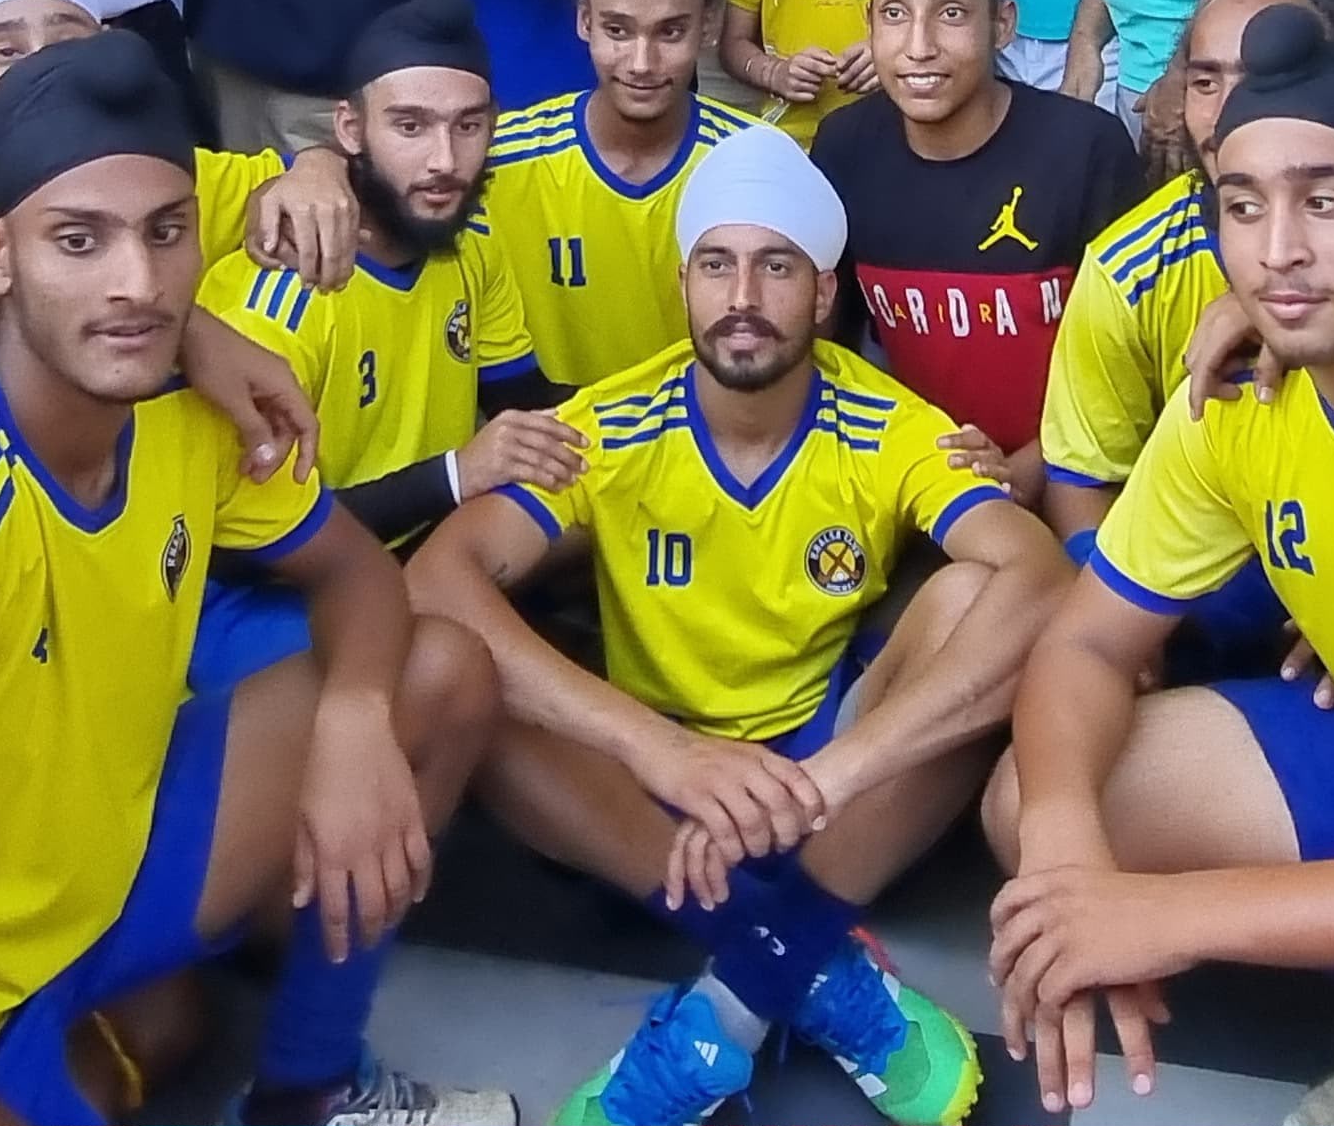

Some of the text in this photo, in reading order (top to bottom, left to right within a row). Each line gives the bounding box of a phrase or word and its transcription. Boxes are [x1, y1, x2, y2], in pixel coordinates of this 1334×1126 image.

[548, 237, 588, 288] 11
[857, 277, 1062, 337] ORDAN
[357, 349, 377, 410] 3
[646, 528, 693, 587] 10
[1265, 499, 1315, 577] 12
